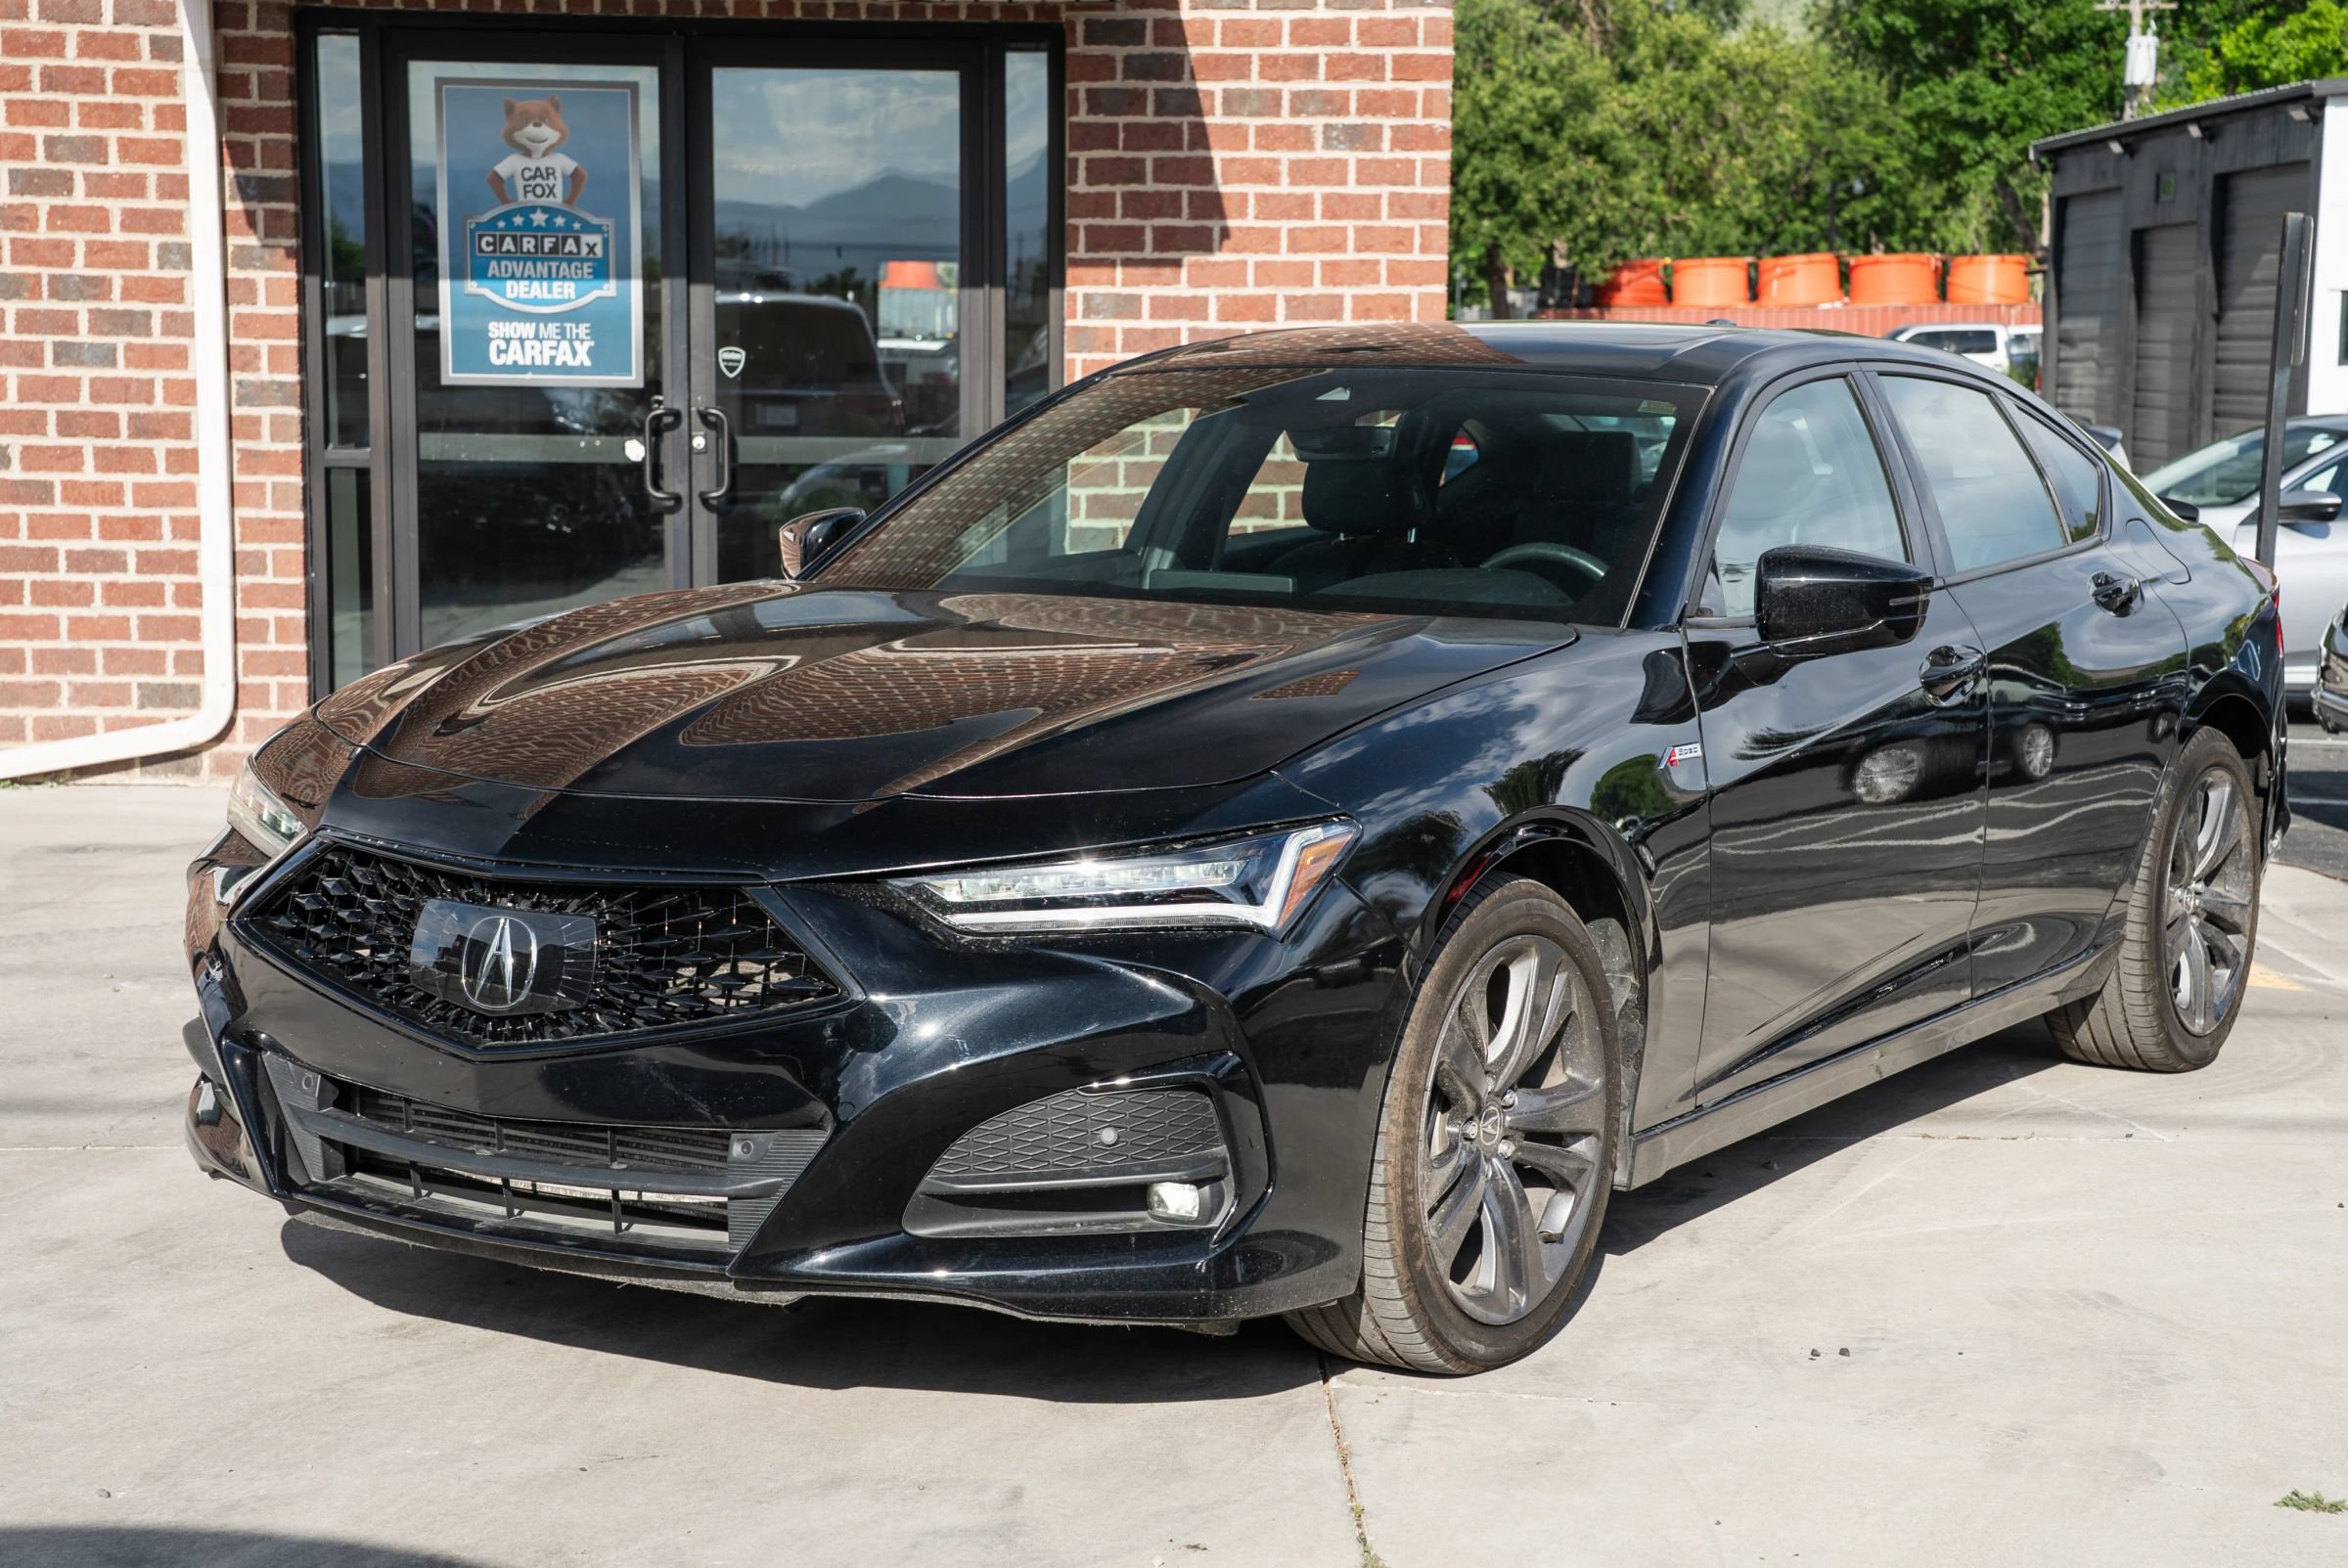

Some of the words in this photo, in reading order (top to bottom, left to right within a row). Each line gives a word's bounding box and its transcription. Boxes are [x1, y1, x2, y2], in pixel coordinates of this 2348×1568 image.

[521, 165, 557, 182] CAR
[523, 183, 557, 199] FOX
[480, 235, 599, 257] CARFAX
[487, 260, 595, 280] ADVANTAGE
[505, 280, 576, 300] DEALER
[488, 321, 537, 339] SHOW
[539, 323, 562, 340] ME
[563, 323, 592, 340] THE
[488, 338, 594, 367] CARFAX
